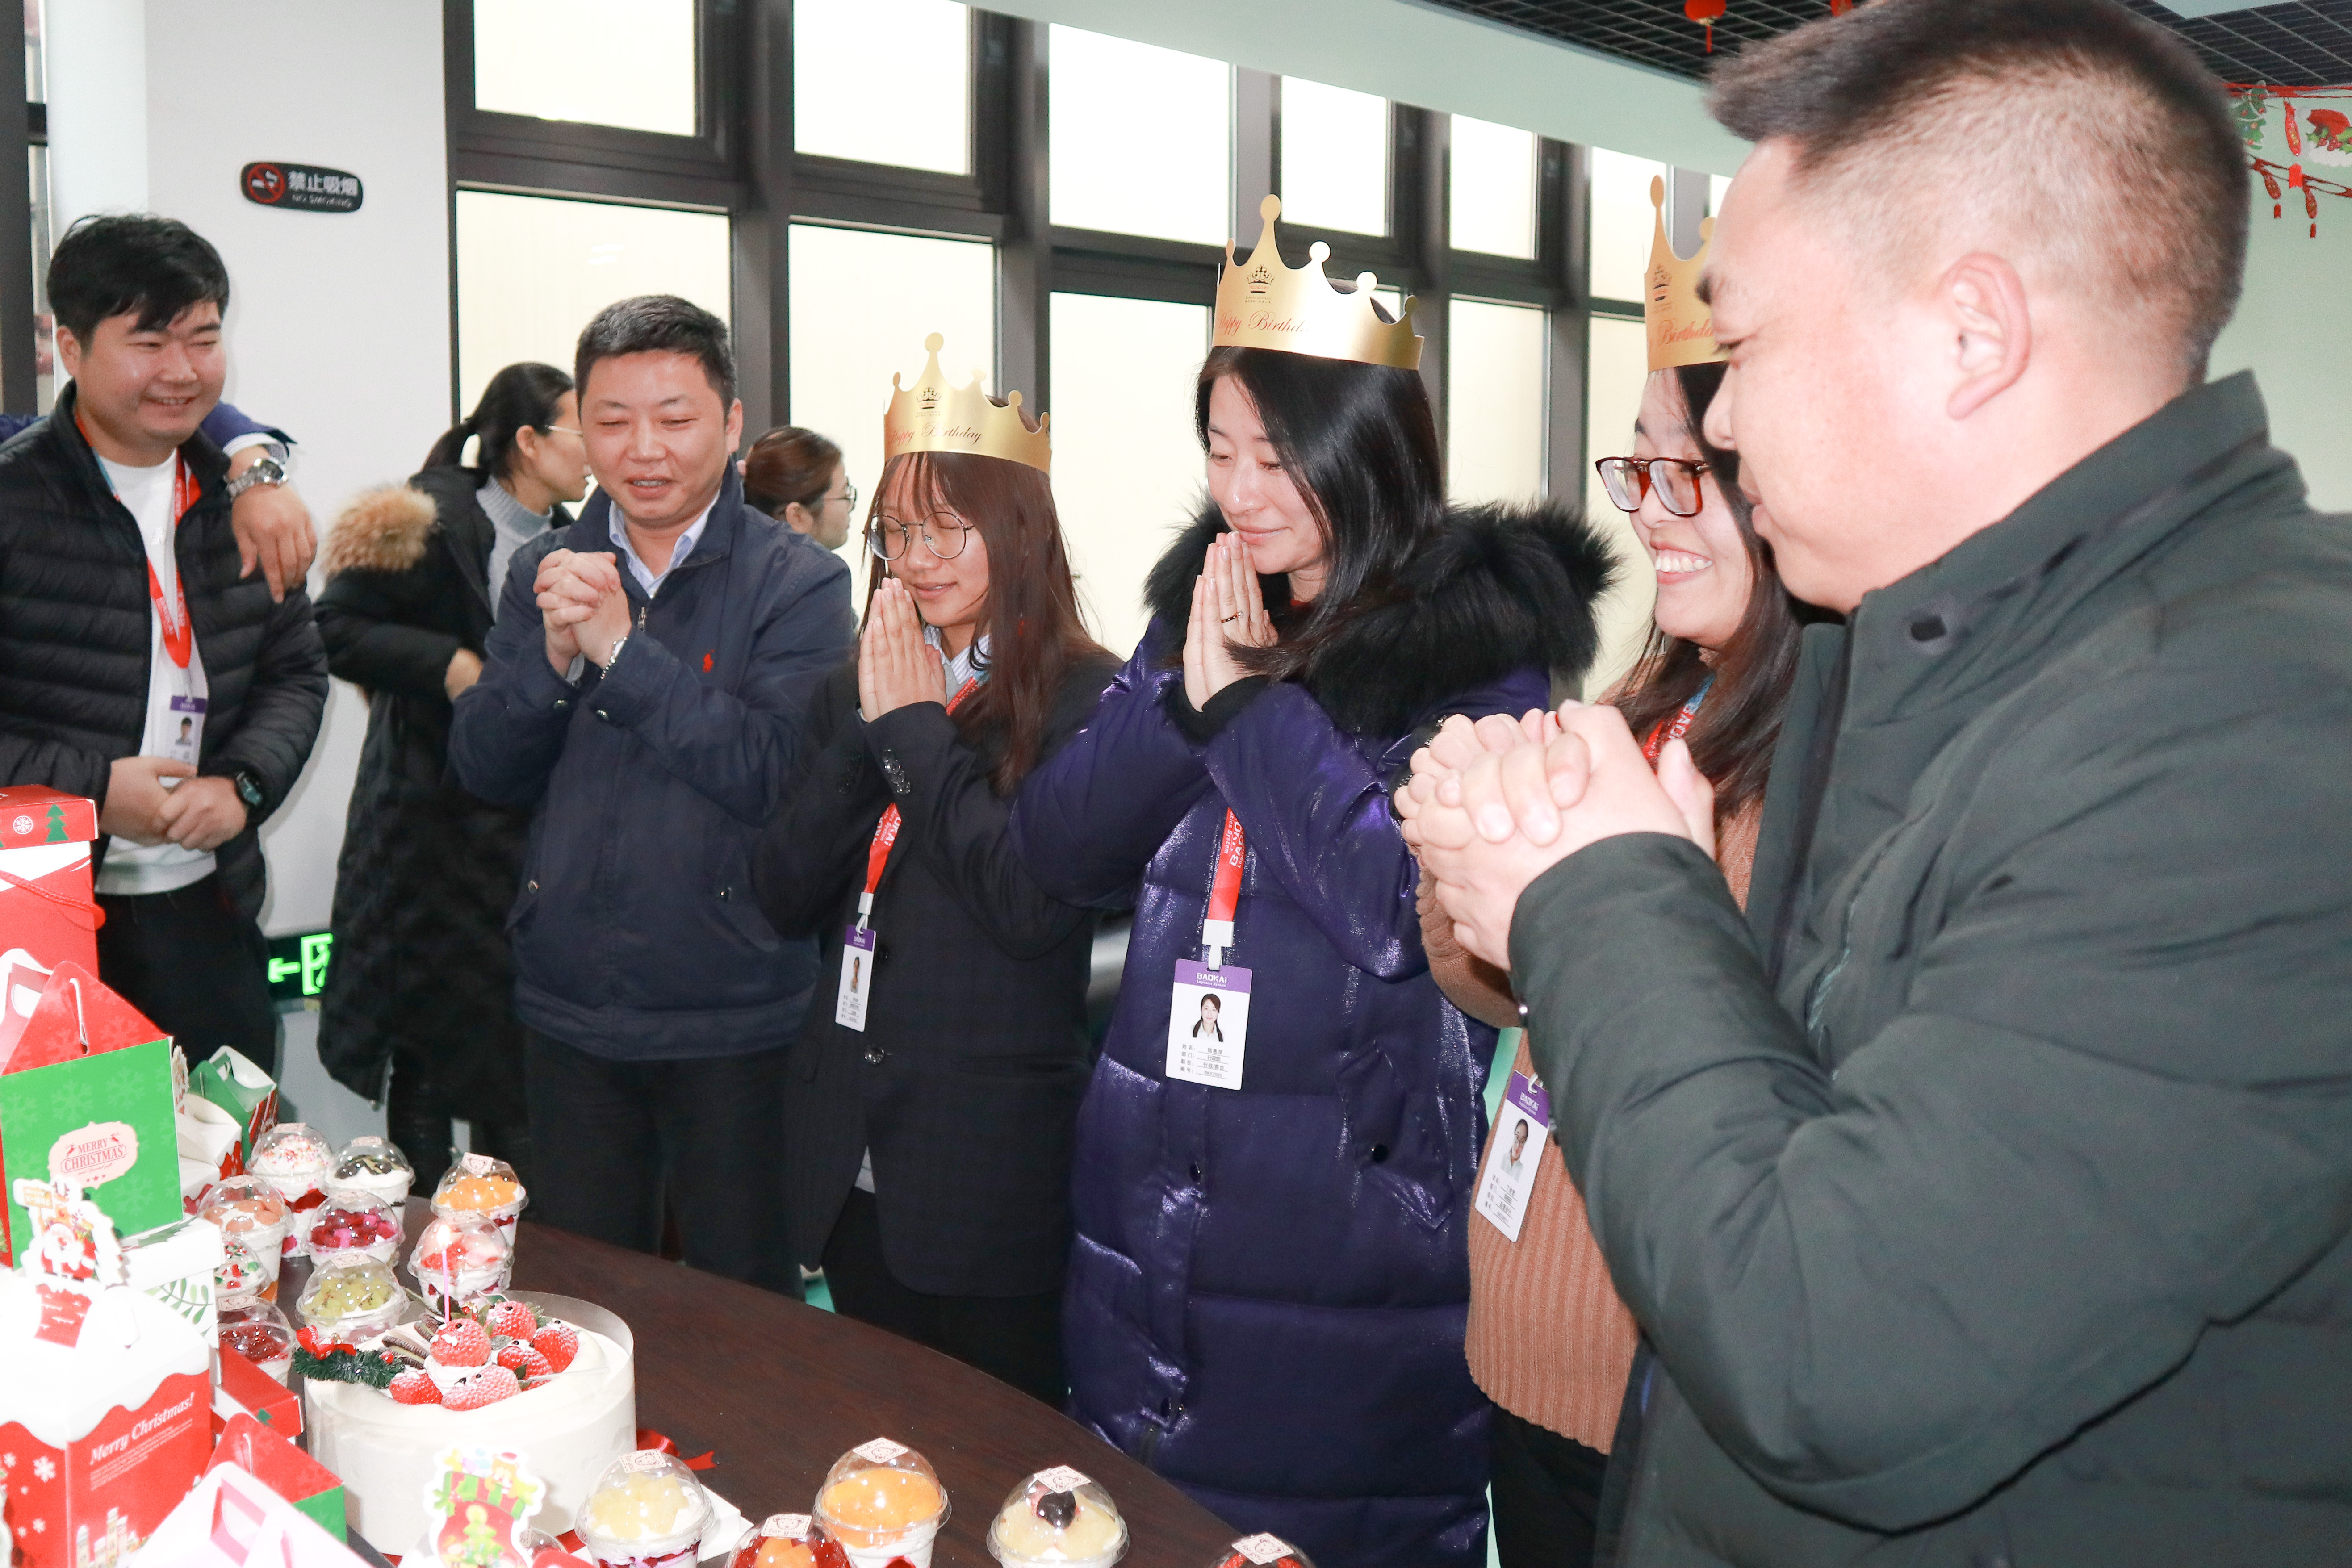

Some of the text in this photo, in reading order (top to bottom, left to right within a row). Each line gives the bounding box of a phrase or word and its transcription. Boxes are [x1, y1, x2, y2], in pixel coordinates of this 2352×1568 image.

[921, 421, 982, 445] Brthday
[78, 1137, 108, 1154] MERRY
[64, 1146, 123, 1171] CHRISTMAS
[90, 1434, 130, 1466] Merry
[131, 1391, 195, 1440] Christmas!
